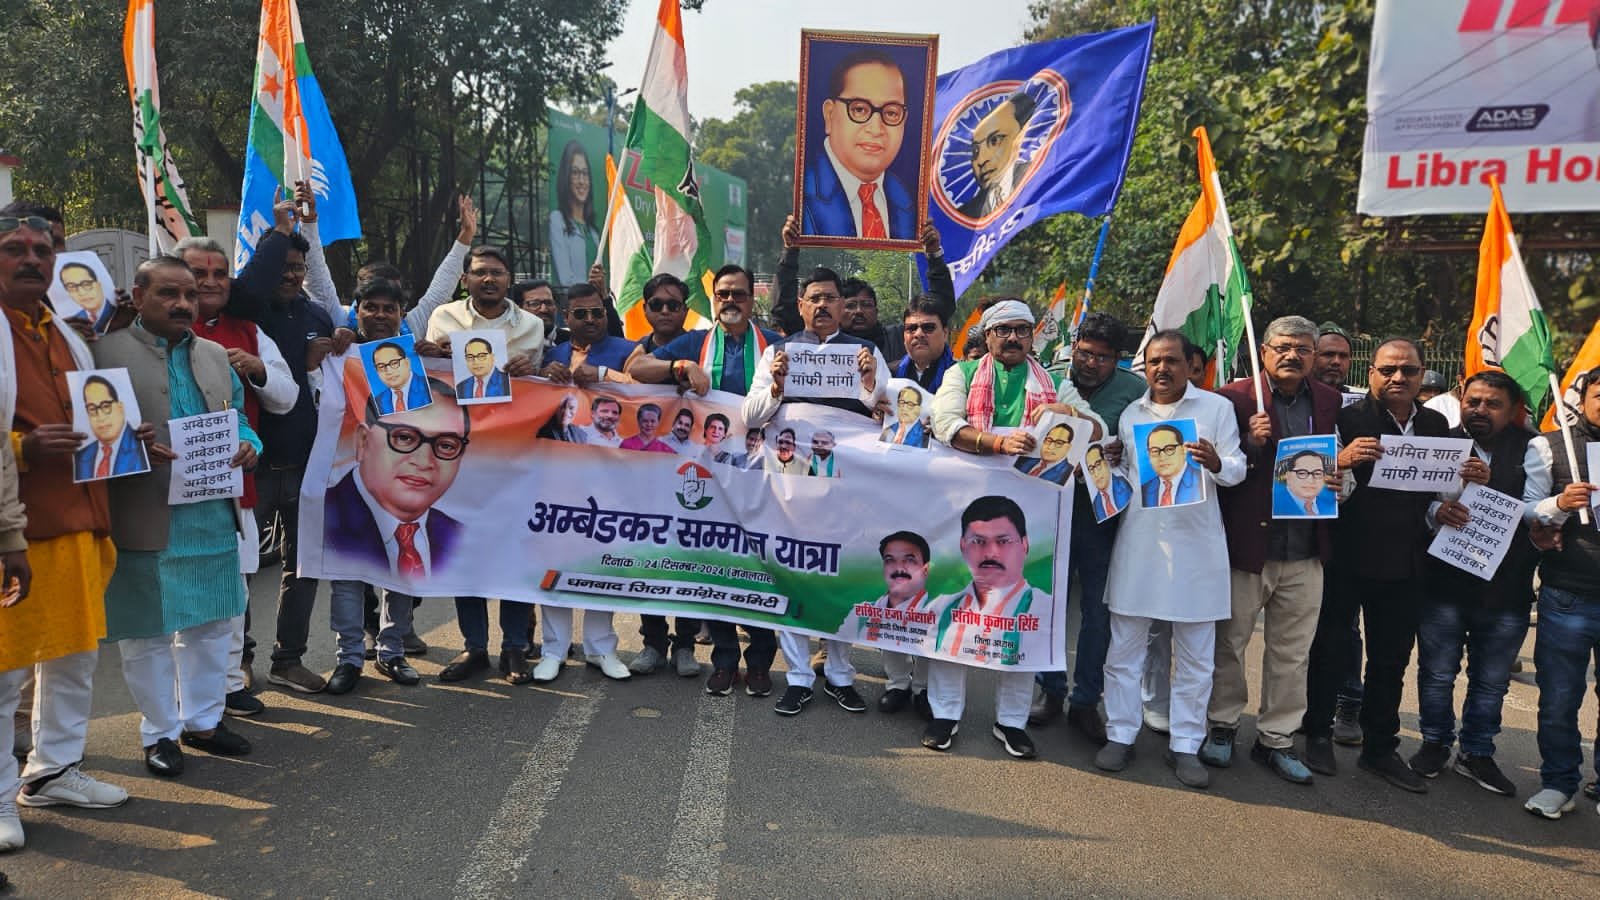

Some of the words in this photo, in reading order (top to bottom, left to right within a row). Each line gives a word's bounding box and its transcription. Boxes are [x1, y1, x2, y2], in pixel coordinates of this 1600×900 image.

[1478, 108, 1536, 121] ADAS
[1387, 152, 1507, 189] Libra
[1525, 147, 1600, 185] Ho
[791, 349, 826, 366] अमित
[830, 353, 856, 367] शाह
[181, 414, 230, 431] अम्बेडकर
[183, 428, 231, 447] अम्बेडकर
[184, 443, 232, 461] अम्बेडकर
[1386, 443, 1429, 460] अमित
[1432, 448, 1464, 462] शाह
[183, 471, 233, 488] अम्बेडकर
[181, 485, 234, 499] अम्बेडकर
[1476, 487, 1519, 512] अम्बेडकर
[1468, 500, 1513, 525] अम्बेडकर
[527, 495, 674, 544] अम्बेडकर
[676, 517, 769, 561] सम्मान
[774, 535, 842, 573] यात्रा
[1470, 513, 1508, 537] म्बेडकर
[1448, 535, 1494, 561] अम्बेडकर
[644, 559, 658, 569] 24
[699, 564, 724, 576] 2024
[1441, 545, 1488, 572] अम्बेडकर
[567, 578, 624, 591] धनबाद
[628, 581, 671, 595] जिला
[675, 586, 728, 600] कांग्रेस
[729, 593, 779, 609] कमिटी
[952, 608, 980, 626] संतोष
[983, 614, 1015, 633] कुमार
[1017, 613, 1040, 632] सिंह
[974, 634, 990, 646] जिला
